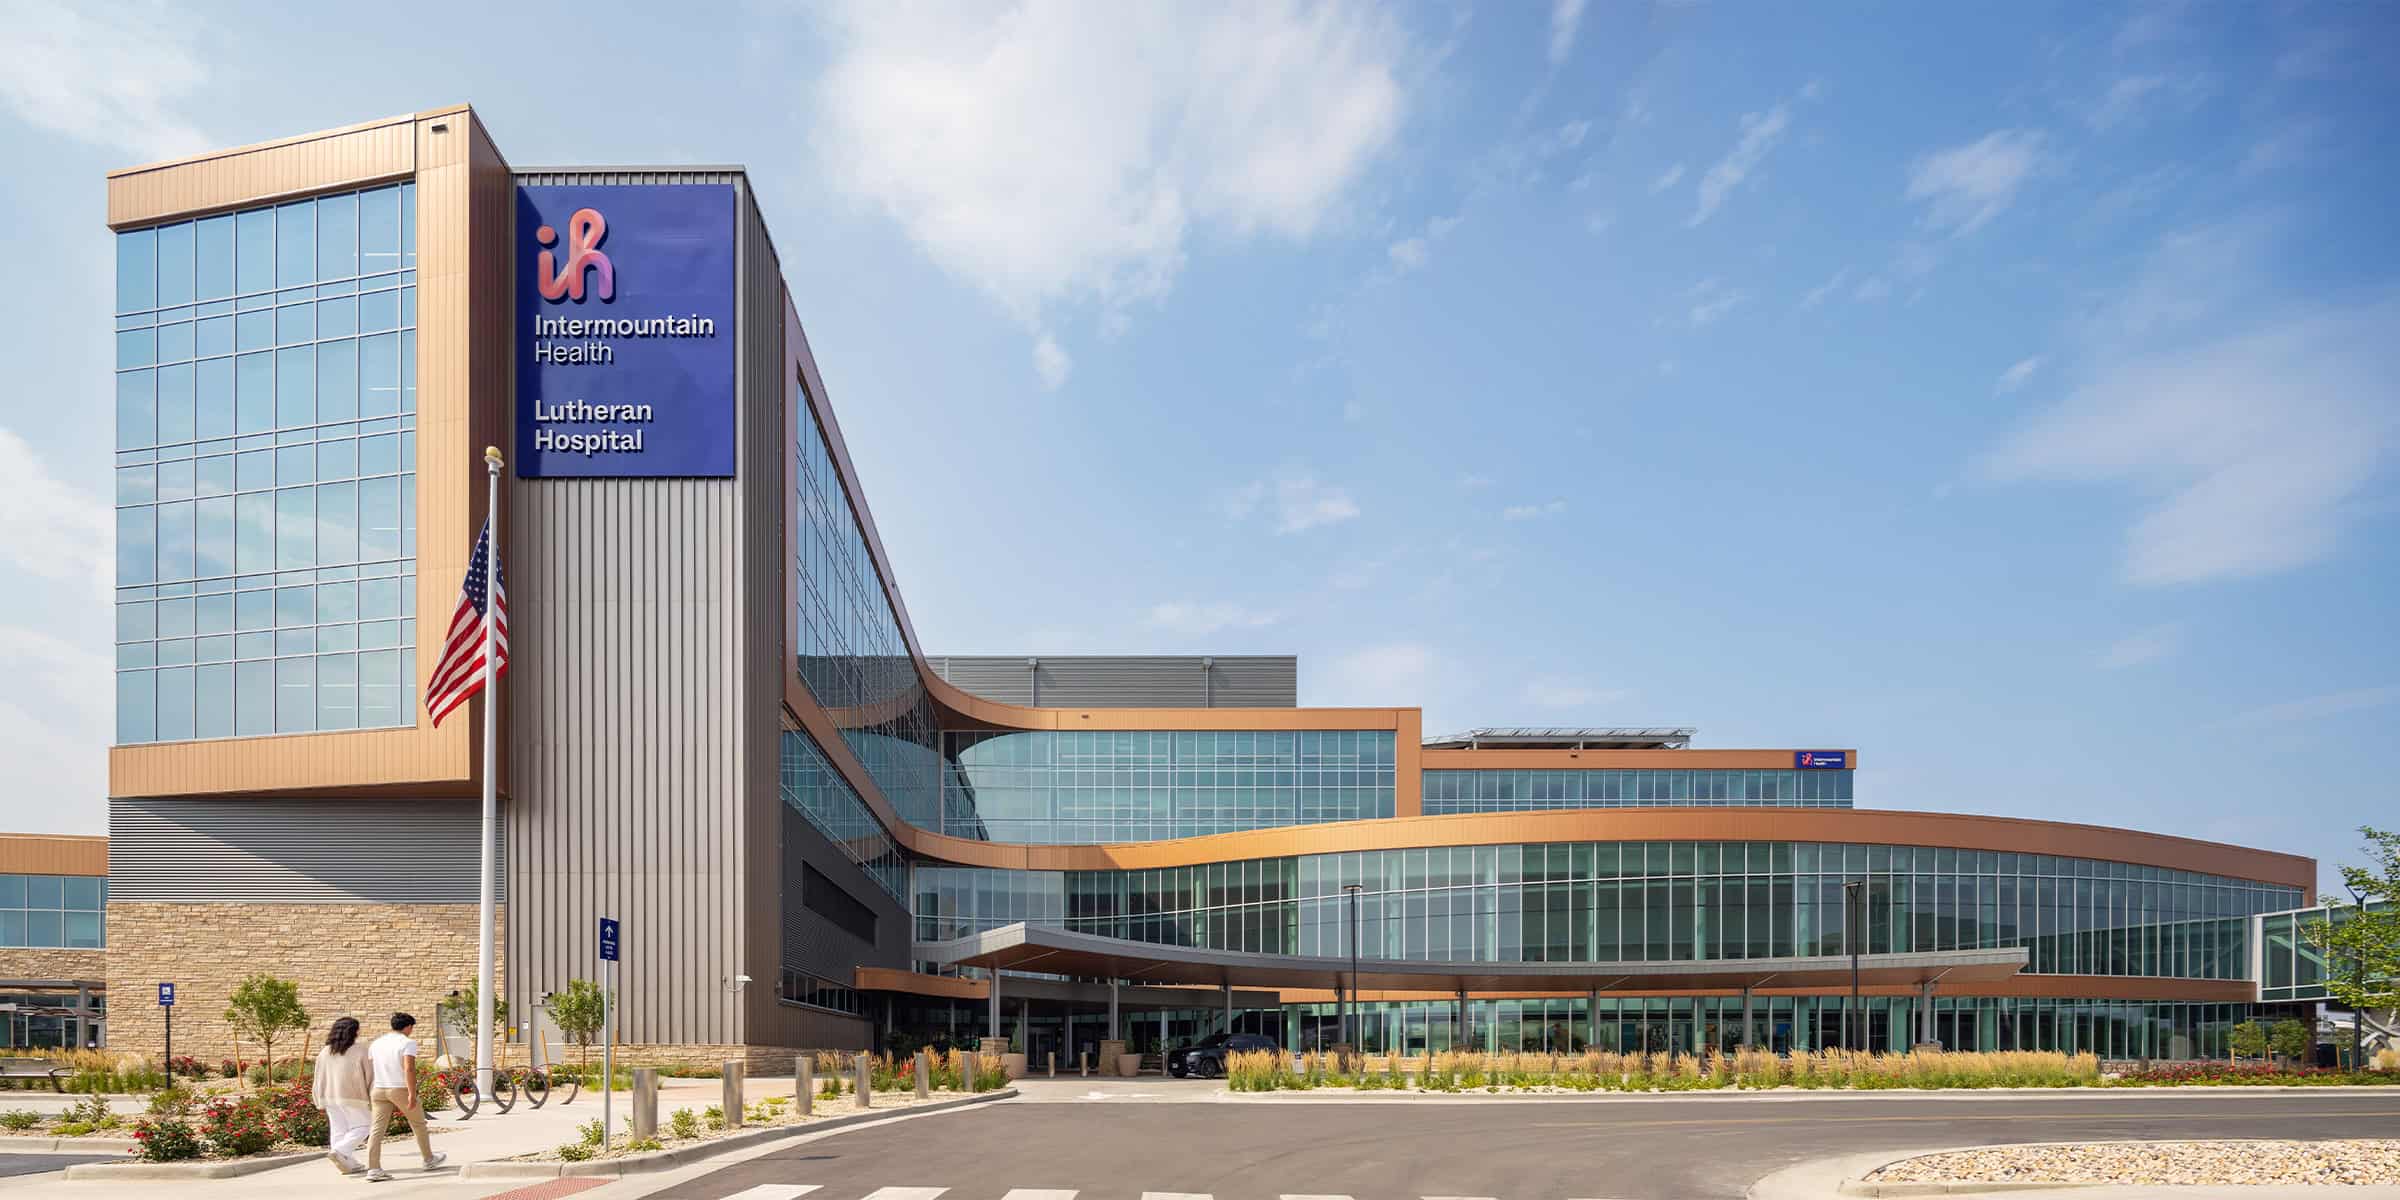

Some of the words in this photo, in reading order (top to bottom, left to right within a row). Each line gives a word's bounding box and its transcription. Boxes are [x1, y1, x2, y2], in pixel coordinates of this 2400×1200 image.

[535, 314, 714, 336] Intermountain
[535, 341, 612, 363] Health
[535, 399, 652, 421] Lutheran
[535, 428, 642, 456] Hospital
